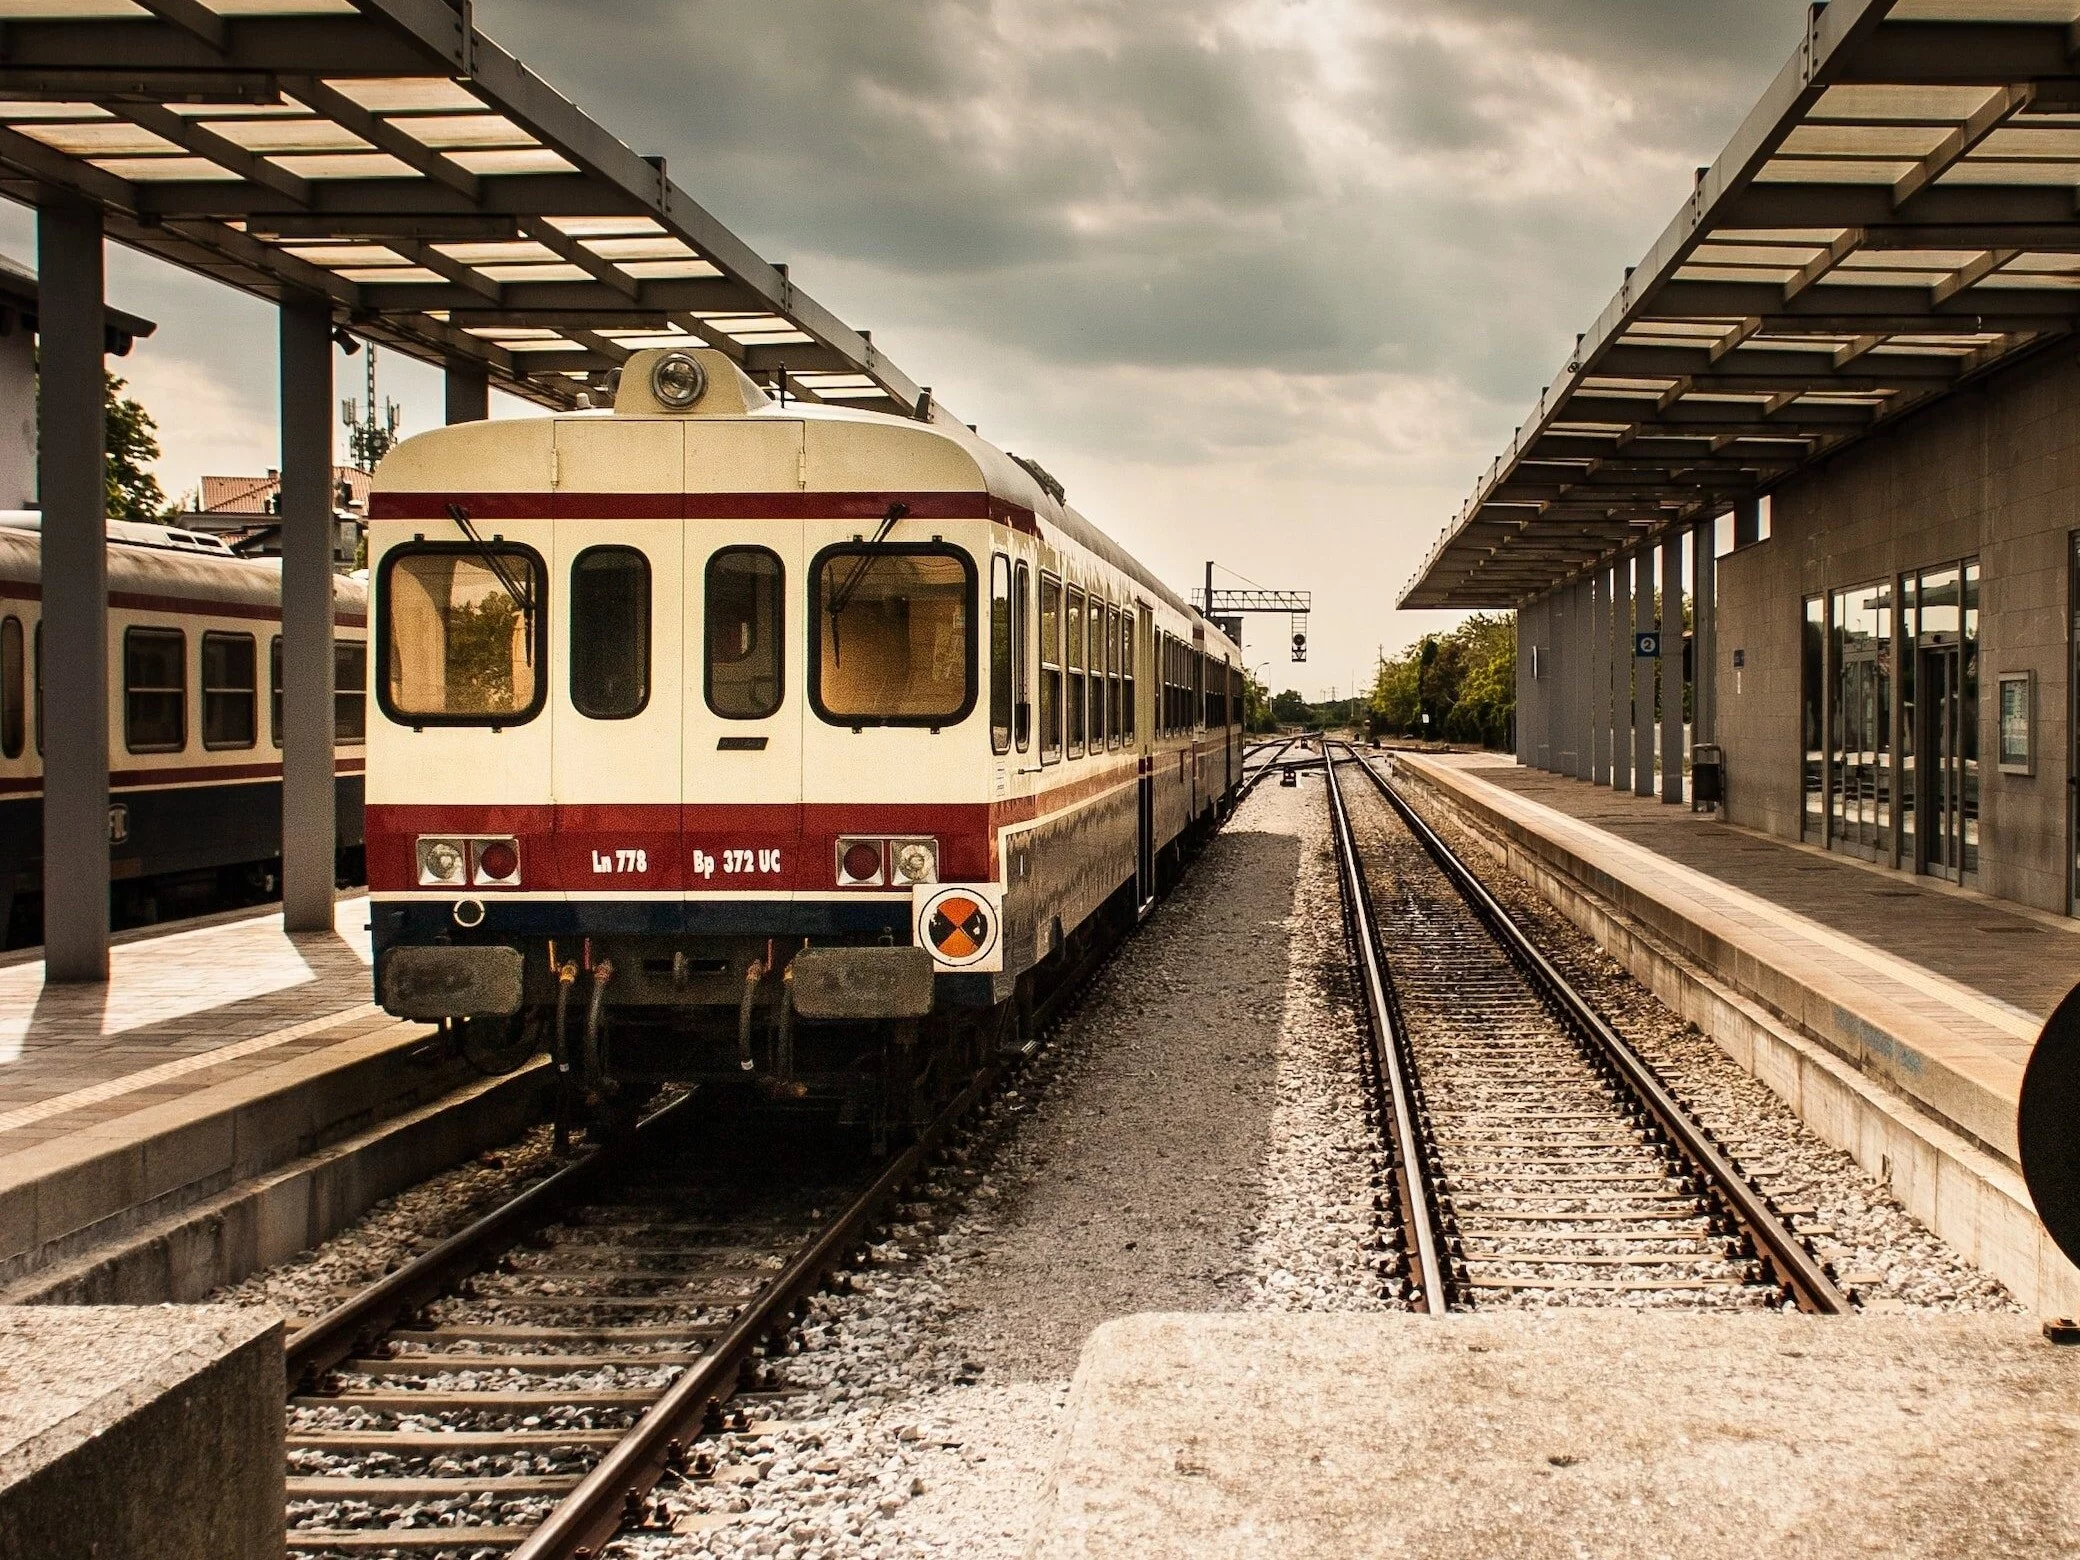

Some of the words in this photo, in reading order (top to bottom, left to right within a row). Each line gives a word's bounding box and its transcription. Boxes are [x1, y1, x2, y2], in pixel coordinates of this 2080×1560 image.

[1643, 639, 1653, 651] 2
[592, 850, 612, 873] Ln
[615, 850, 648, 873] 778
[693, 850, 715, 879] Bp
[723, 850, 755, 873] 372
[758, 849, 781, 873] UC
